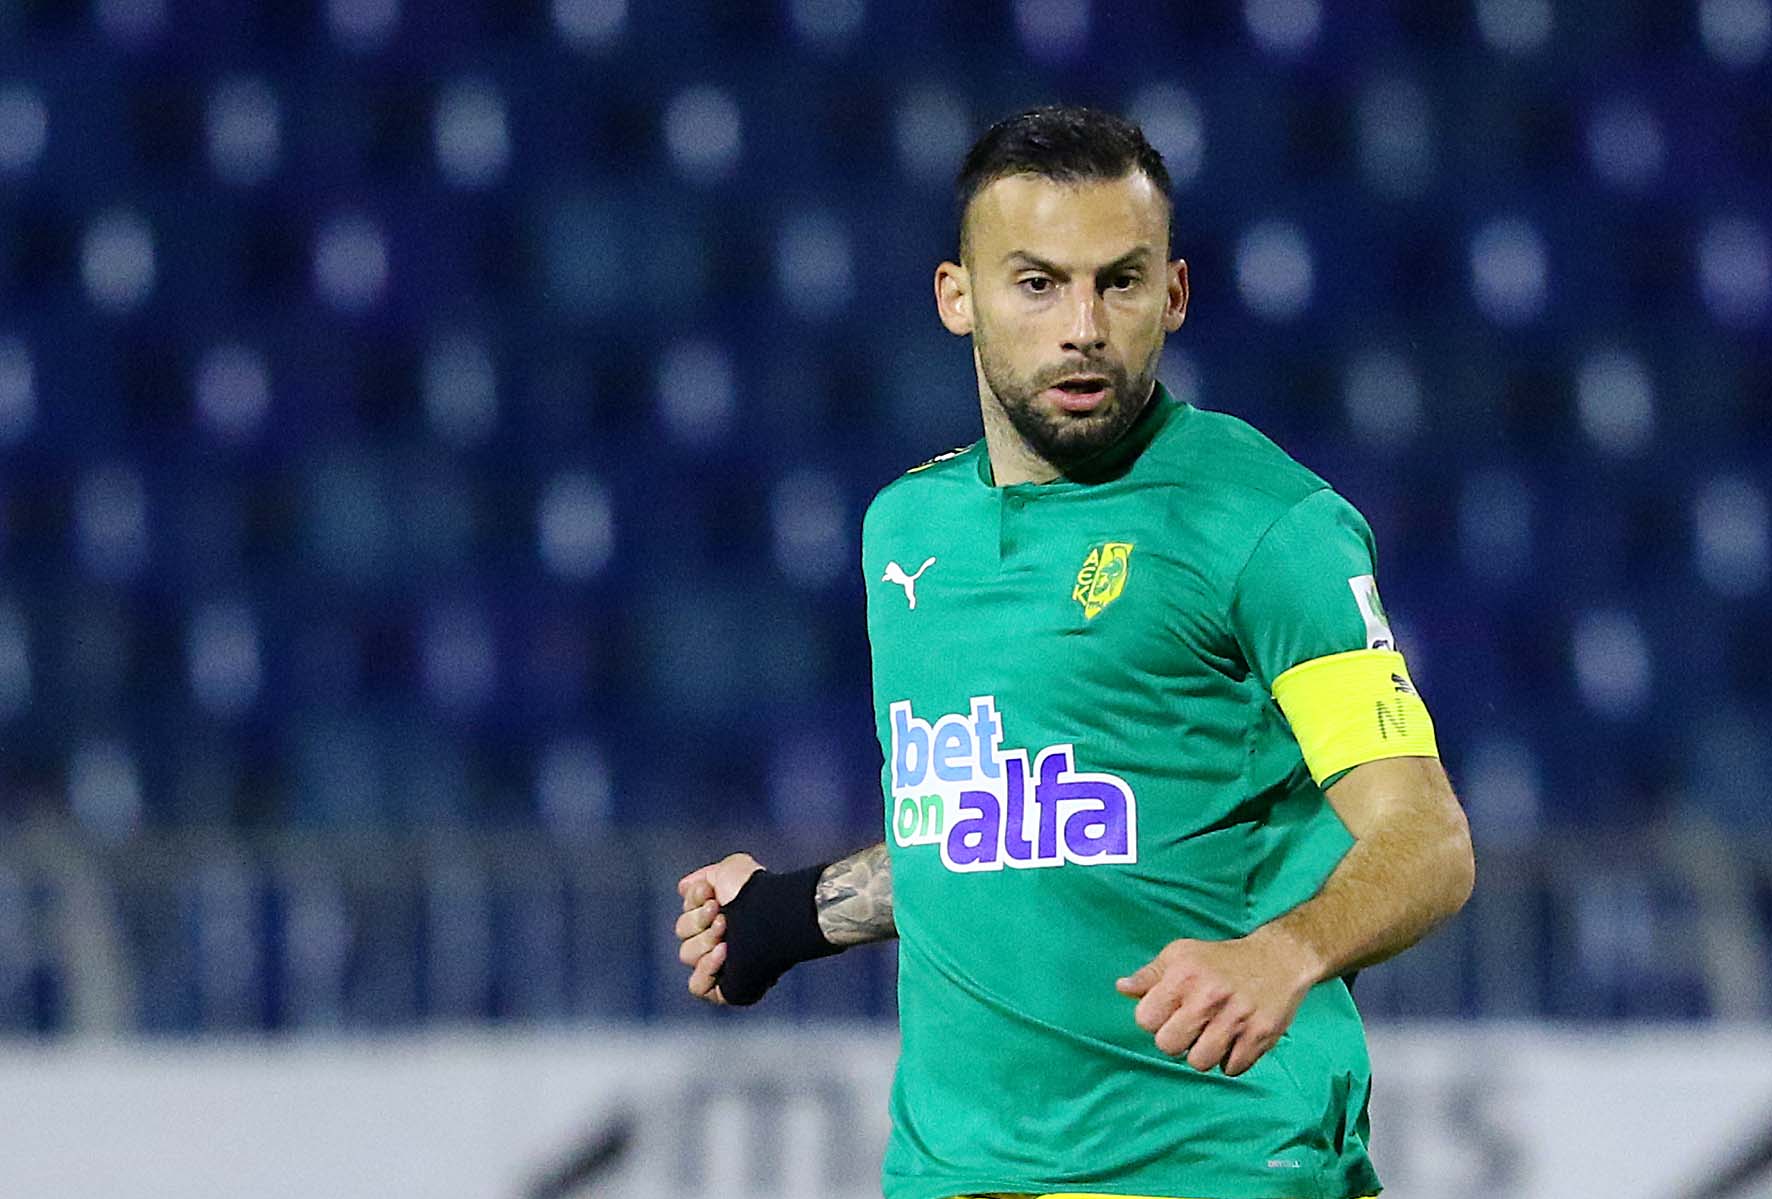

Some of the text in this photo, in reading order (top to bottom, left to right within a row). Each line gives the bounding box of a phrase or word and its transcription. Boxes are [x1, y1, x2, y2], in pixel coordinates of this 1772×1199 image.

[895, 698, 1001, 788] bet
[898, 752, 1128, 866] on alfa
